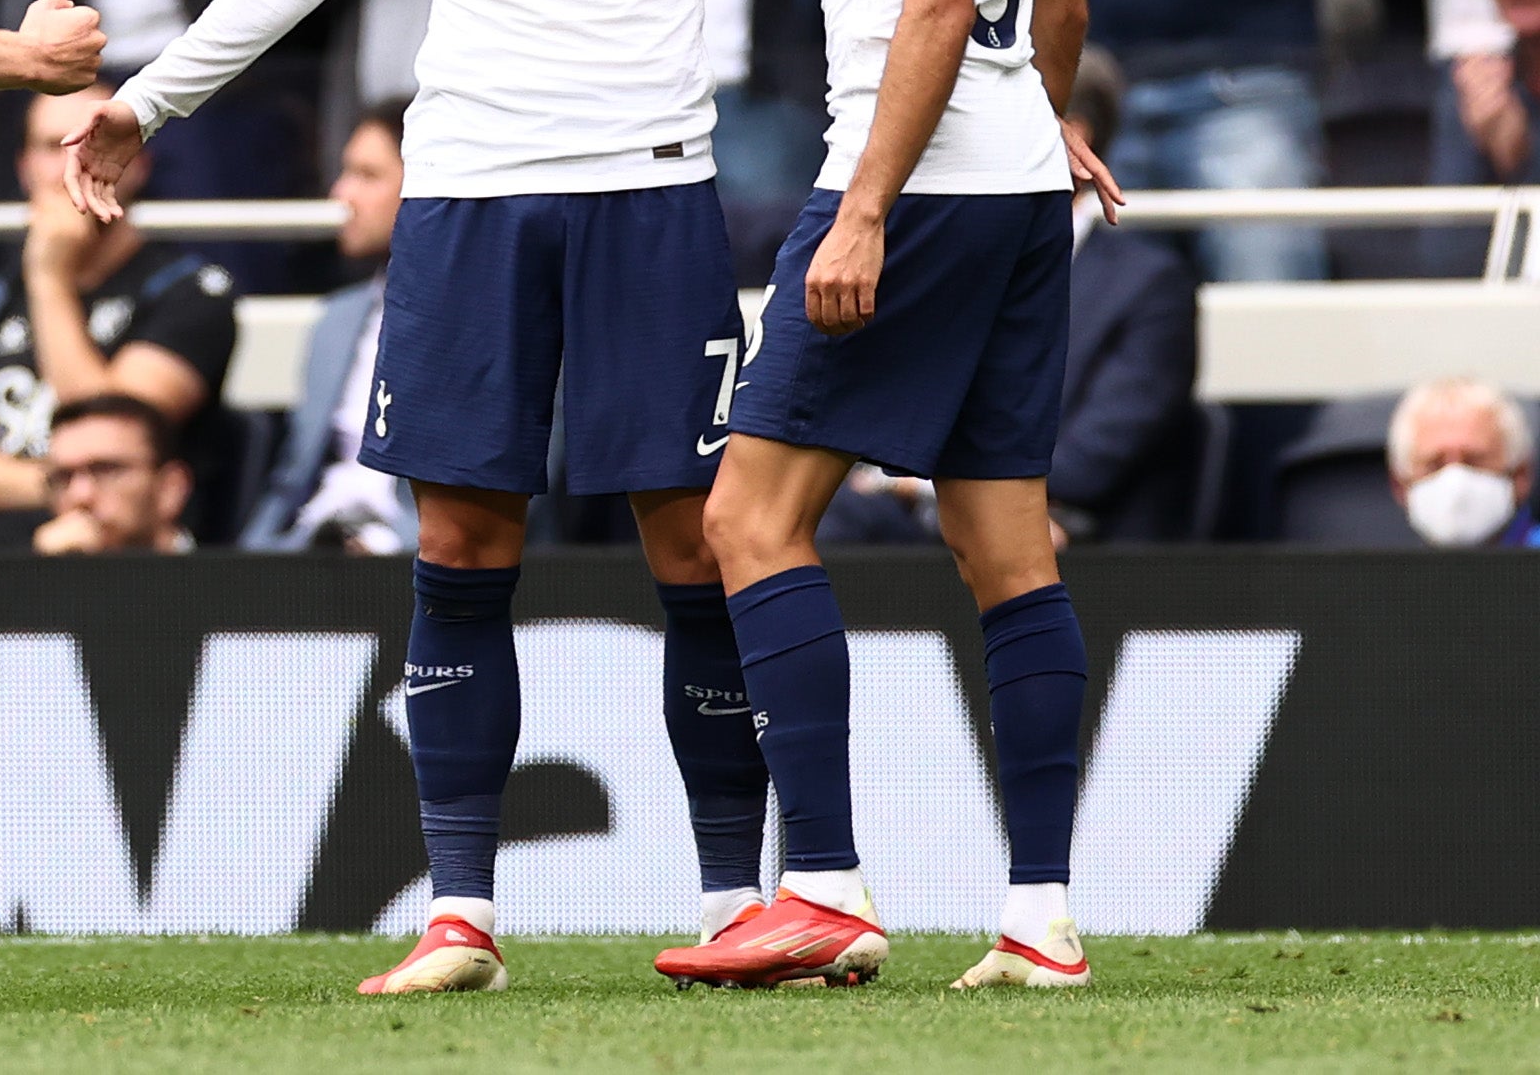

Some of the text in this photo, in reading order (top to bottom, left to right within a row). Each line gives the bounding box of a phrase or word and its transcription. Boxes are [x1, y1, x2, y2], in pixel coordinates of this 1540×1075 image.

[705, 337, 738, 425] 7
[404, 662, 474, 678] PURS
[684, 685, 744, 702] SPU
